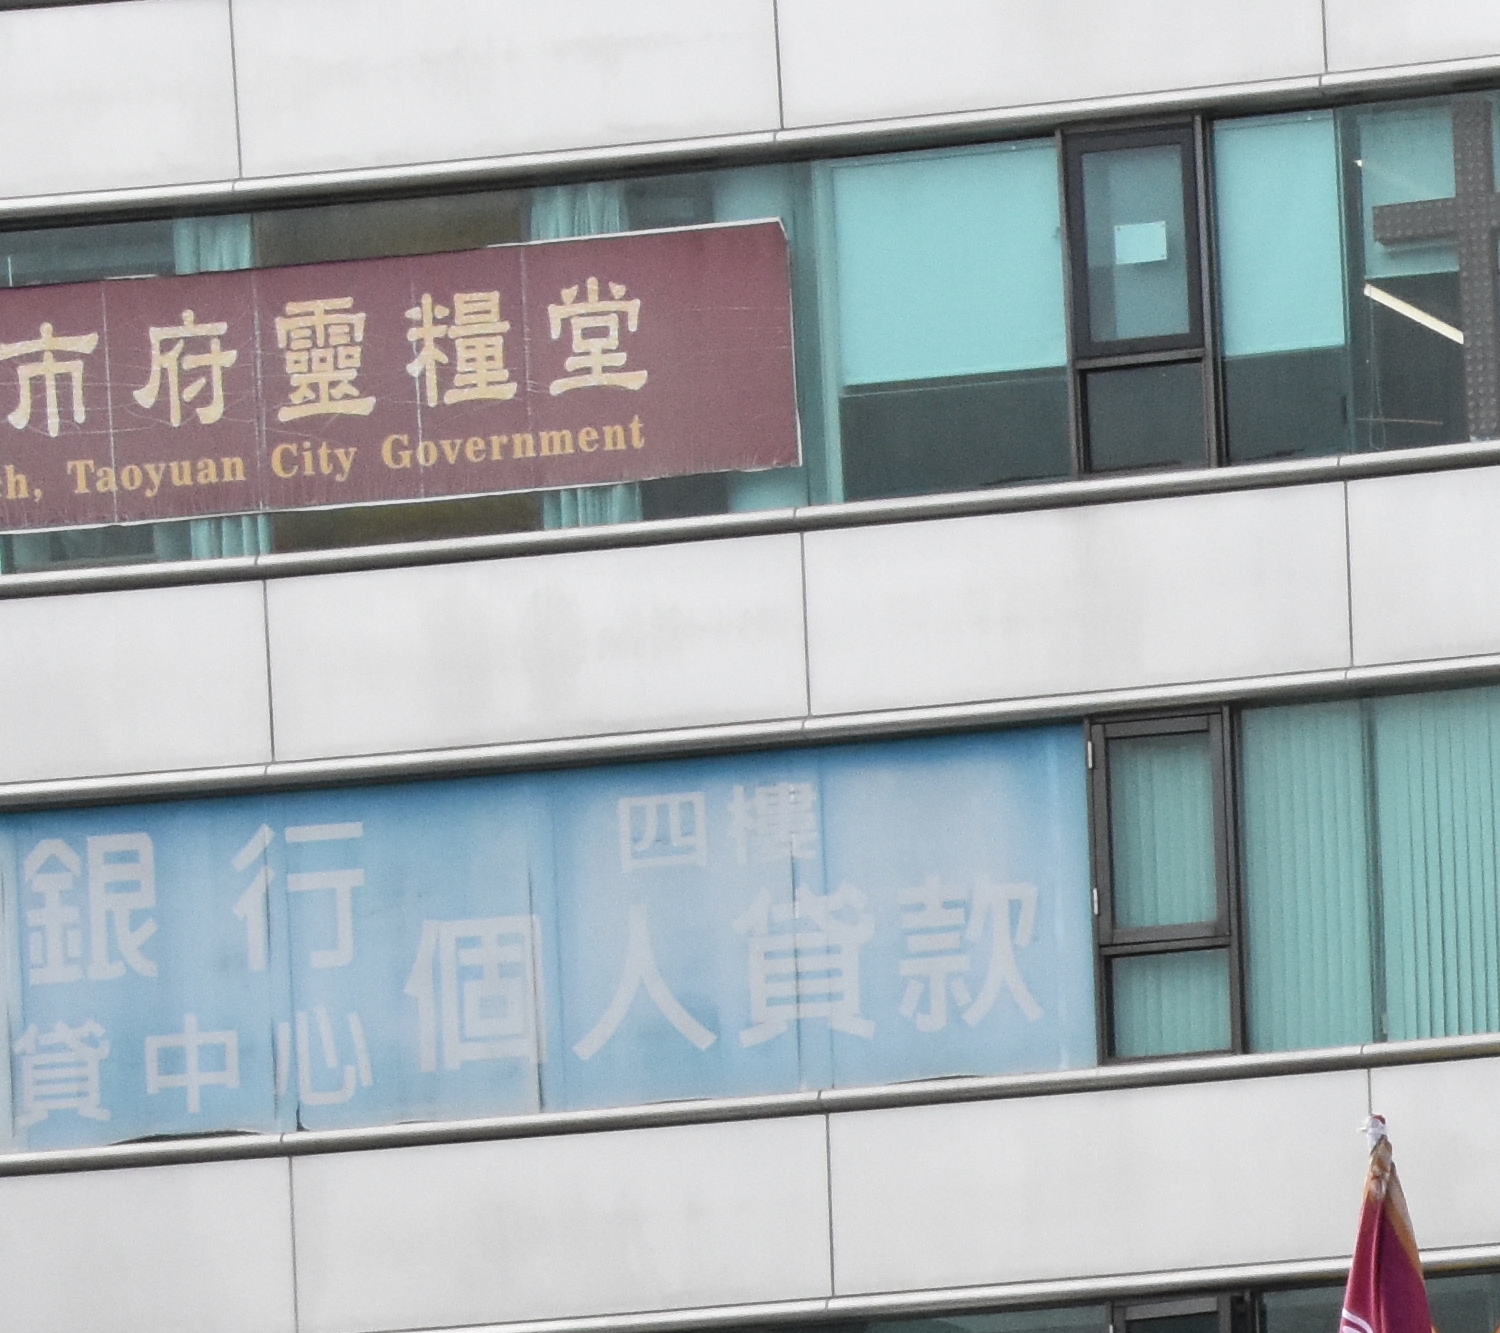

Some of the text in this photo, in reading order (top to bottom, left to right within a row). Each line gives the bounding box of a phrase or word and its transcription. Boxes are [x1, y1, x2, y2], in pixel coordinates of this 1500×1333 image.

[0, 276, 649, 438] 市府靈糧堂
[66, 453, 246, 498] Taoyuan
[270, 440, 358, 483] City
[380, 413, 647, 470] Government
[617, 782, 819, 875] 四樓
[24, 821, 366, 985] 銀行
[403, 877, 1045, 1074] 個人貸款
[13, 1005, 374, 1128] 貸中心
